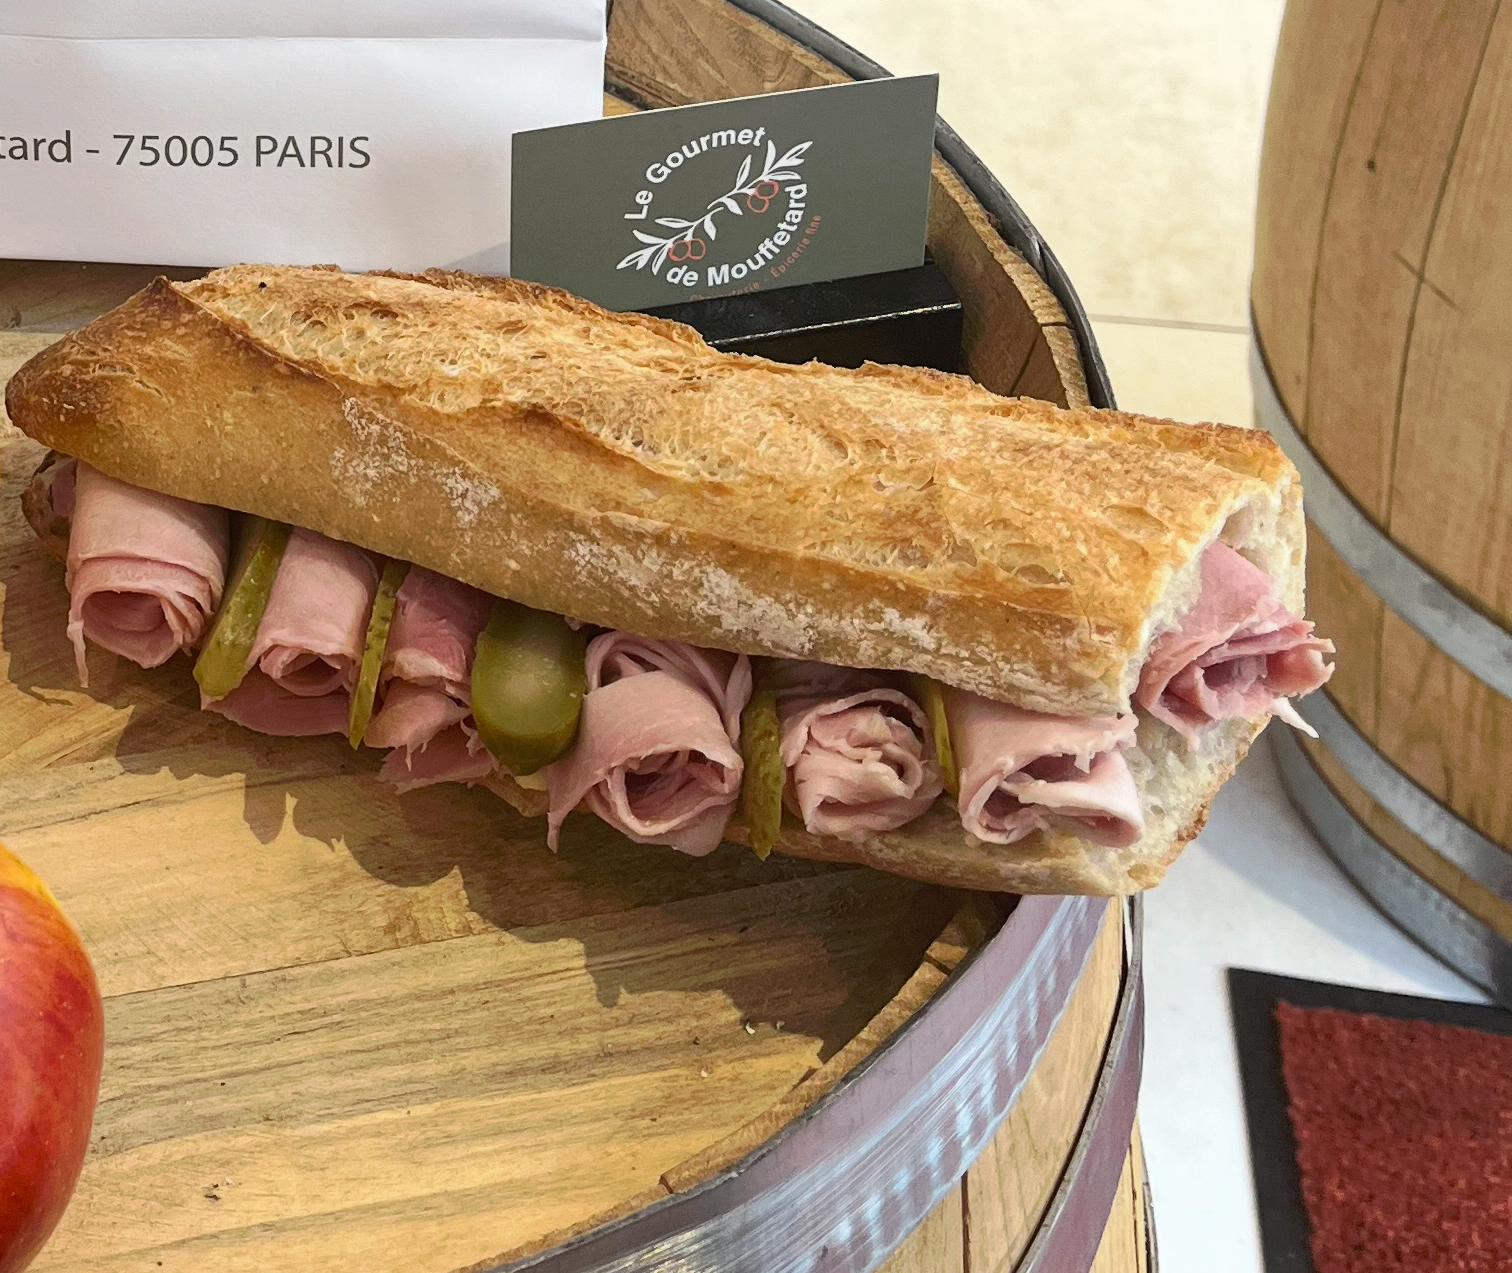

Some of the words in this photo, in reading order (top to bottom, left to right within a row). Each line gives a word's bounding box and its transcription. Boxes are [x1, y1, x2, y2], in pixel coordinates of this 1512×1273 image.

[111, 133, 241, 169] 75005
[254, 134, 372, 170] PARIS
[624, 189, 654, 221] Le
[645, 126, 766, 184] Gourmet
[666, 264, 699, 287] de
[707, 182, 808, 287] Mouffetard
[770, 237, 811, 279] Épicerie
